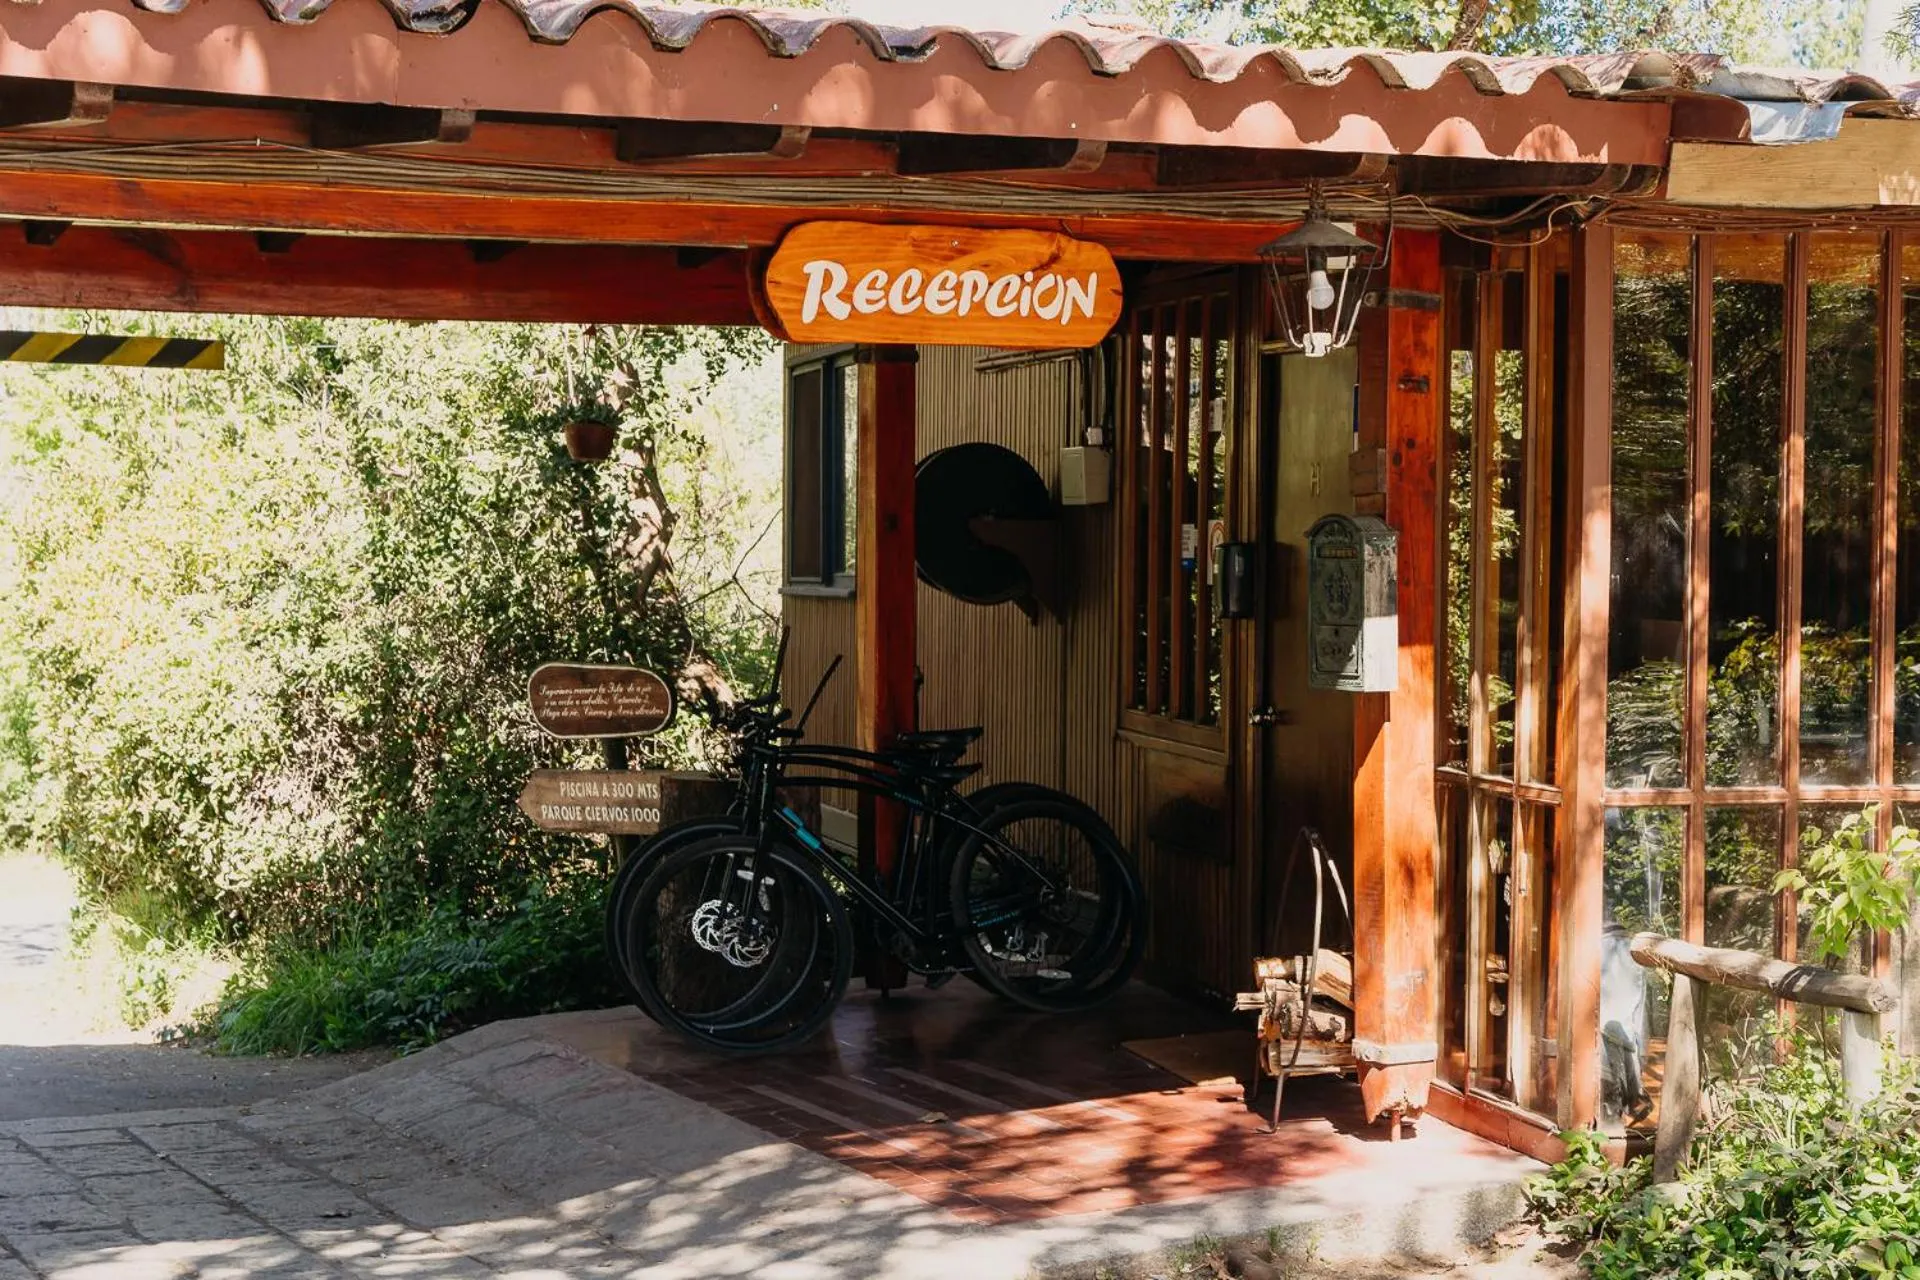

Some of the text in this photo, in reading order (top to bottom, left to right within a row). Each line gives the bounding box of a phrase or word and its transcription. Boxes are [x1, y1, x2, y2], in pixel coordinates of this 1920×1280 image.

[560, 781, 600, 798] PISCINA
[602, 783, 609, 797] A
[612, 782, 634, 798] 300
[541, 804, 660, 823] PARQUE CIERVOS 1000
